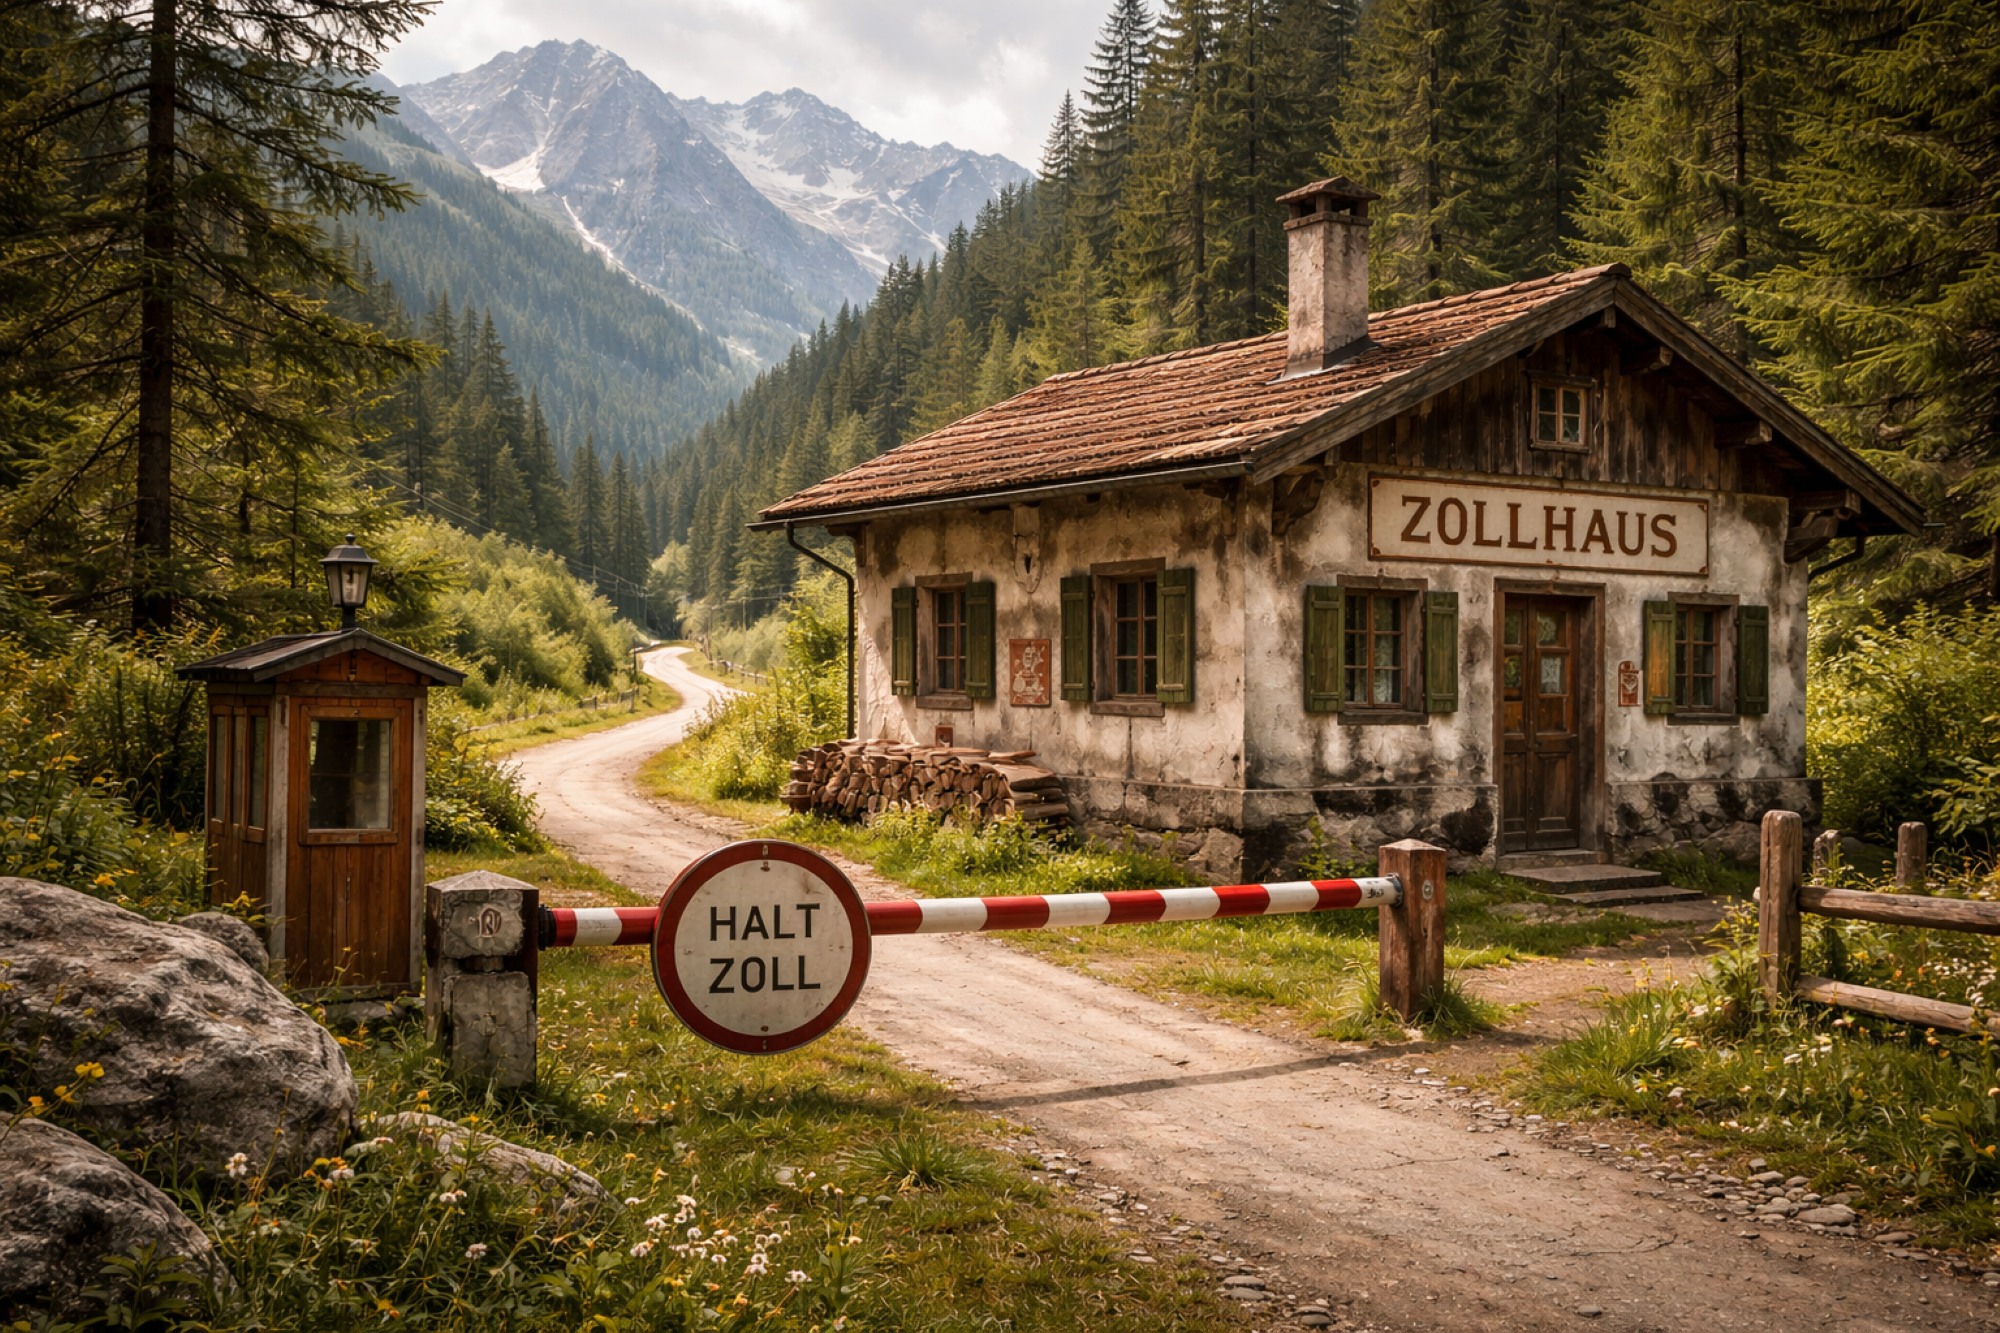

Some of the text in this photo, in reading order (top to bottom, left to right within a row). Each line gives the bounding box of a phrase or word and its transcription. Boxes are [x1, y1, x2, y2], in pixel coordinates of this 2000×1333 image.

[1401, 496, 1677, 557] ZOLLHAUS
[710, 903, 820, 941] HALT
[709, 955, 821, 993] ZOLL
